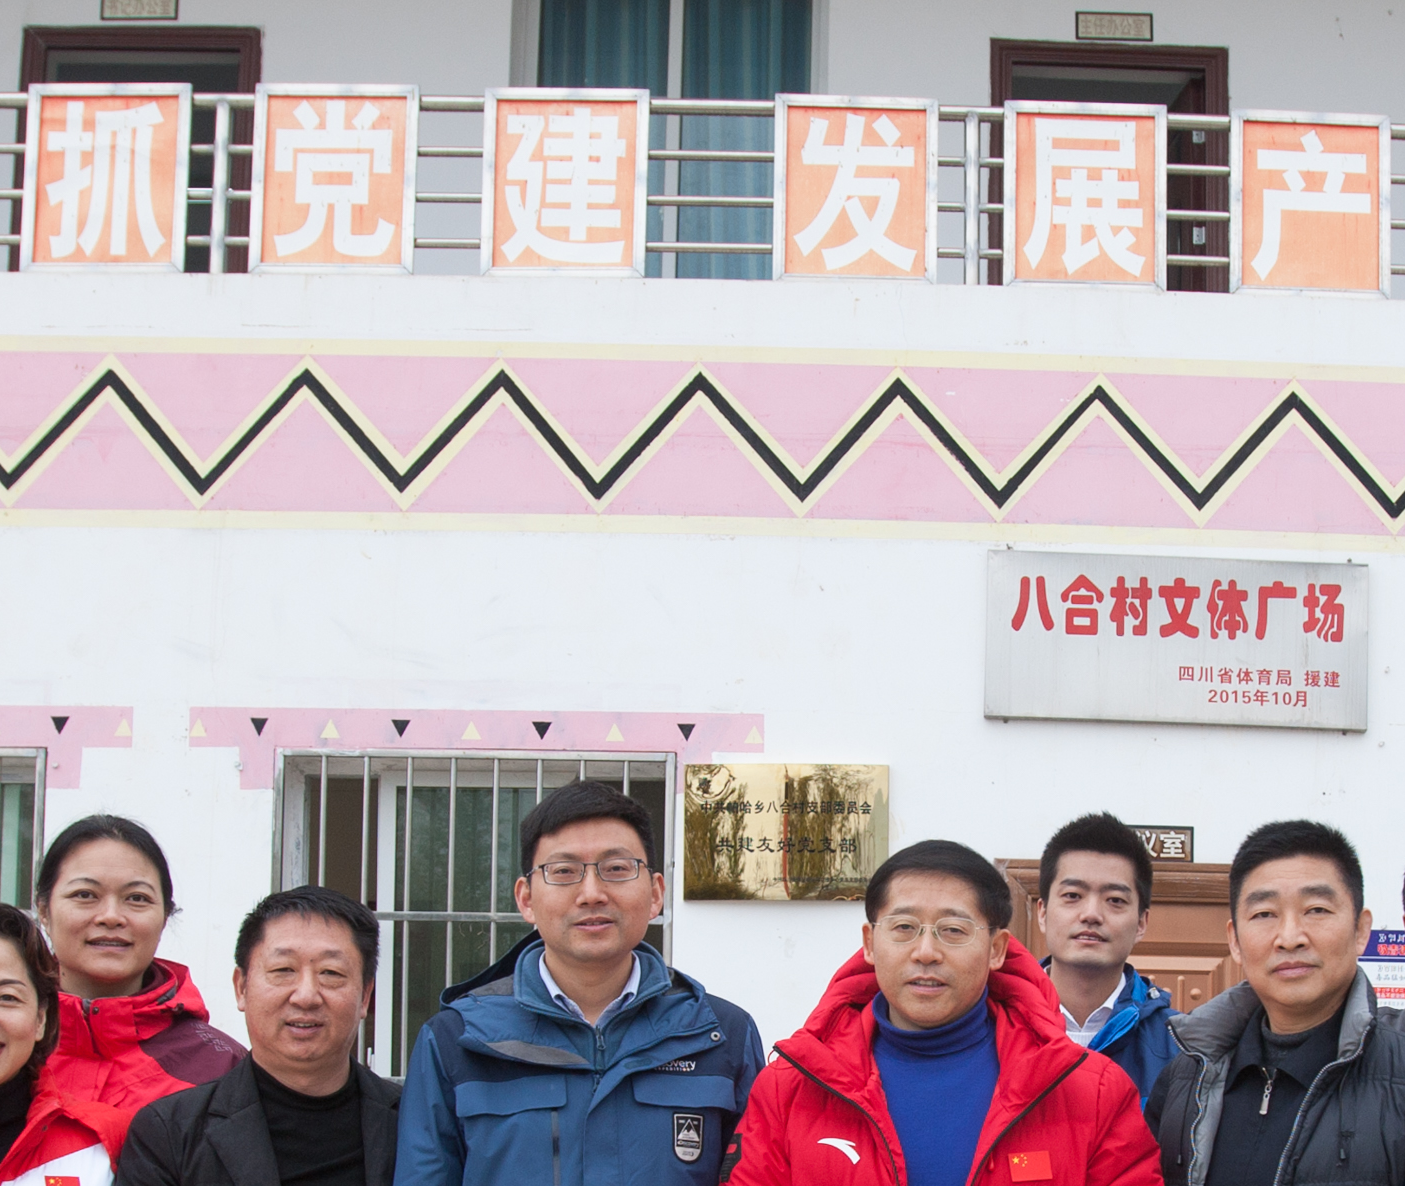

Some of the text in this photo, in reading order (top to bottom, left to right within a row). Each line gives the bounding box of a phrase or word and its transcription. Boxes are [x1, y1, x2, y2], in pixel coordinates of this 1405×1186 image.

[1011, 574, 1345, 643] 八合村文体广场
[1178, 666, 1341, 689] 四川省体育局 援建
[1208, 689, 1309, 708] 2015年10月
[700, 801, 873, 815] 中共帕哈乡八合村支部委员会
[716, 836, 858, 854] 共建友好党支部
